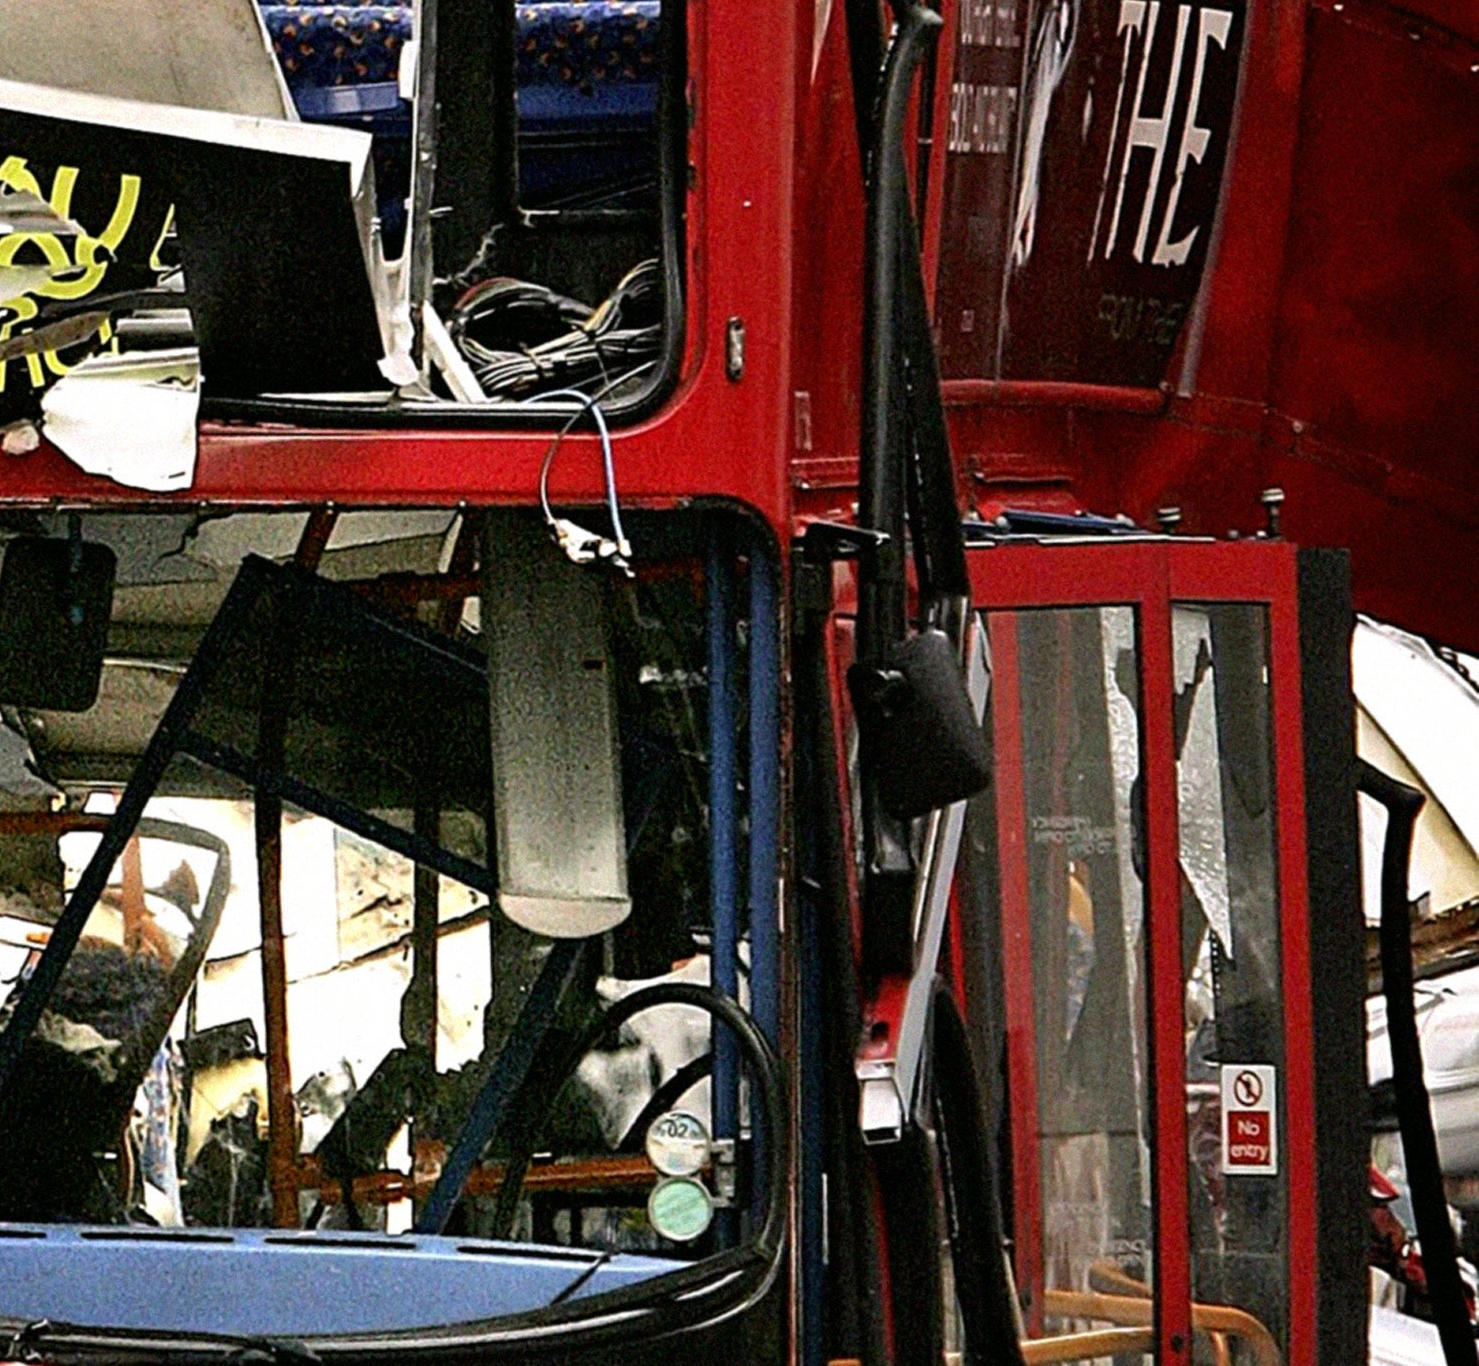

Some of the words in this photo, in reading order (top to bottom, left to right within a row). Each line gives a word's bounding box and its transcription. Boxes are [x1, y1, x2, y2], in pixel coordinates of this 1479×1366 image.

[1088, 0, 1233, 268] THE
[1237, 1120, 1260, 1136] No
[1230, 1145, 1268, 1161] entry
